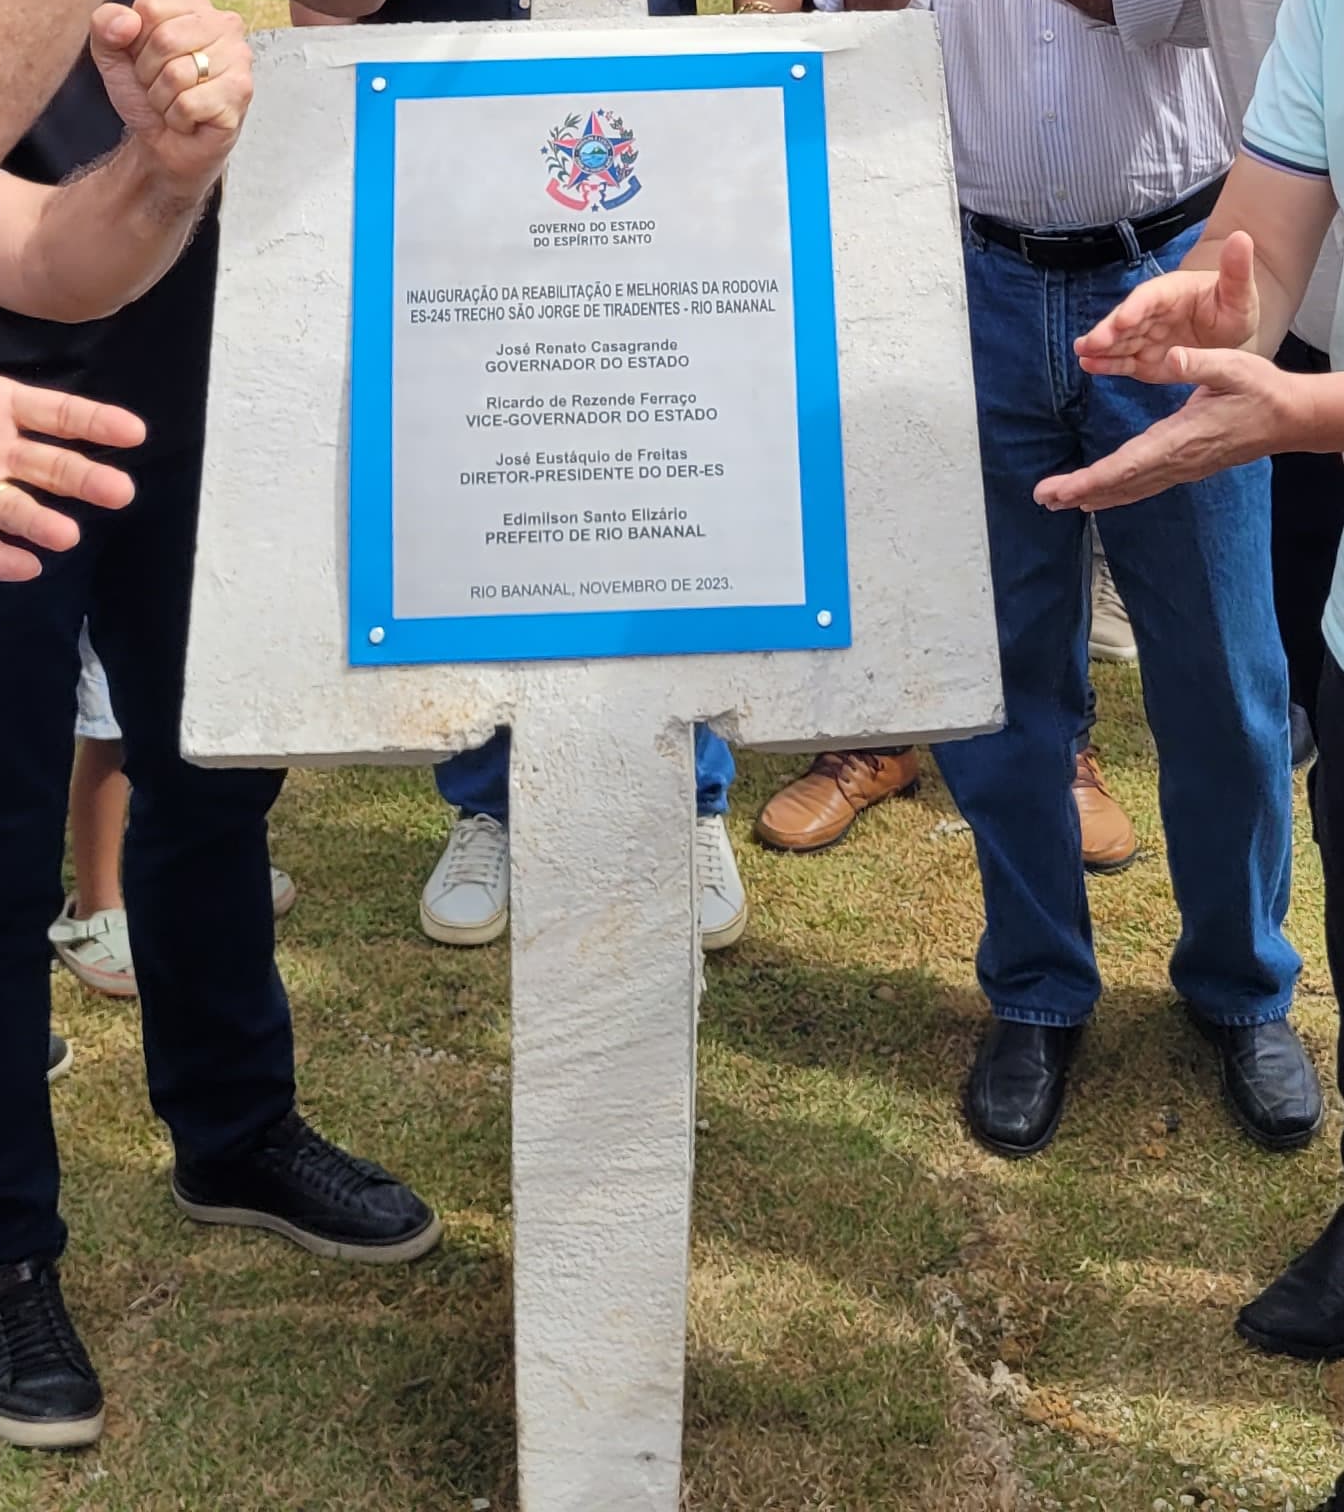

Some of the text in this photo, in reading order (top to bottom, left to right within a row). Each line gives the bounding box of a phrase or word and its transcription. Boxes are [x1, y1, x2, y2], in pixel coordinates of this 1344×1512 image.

[529, 220, 656, 234] GOVERNO DO ESTADO
[533, 233, 652, 248] DO ESPÍRITO SANTO
[406, 279, 779, 305] INAUGURAÇÃO DA REABILITAÇÃO E MELHORIAS DA RODOVIA
[410, 308, 451, 323] ES-245
[454, 306, 505, 322] TRECHO
[508, 303, 535, 321] SÃO
[538, 304, 580, 320] JORGE
[583, 303, 601, 318] DE
[603, 301, 681, 317] TIRADENTES
[691, 299, 713, 315] RIO
[716, 299, 776, 314] BANANAL
[496, 338, 678, 356] José Renato Casagrande
[485, 355, 690, 373] GOVERNADOR DO ESTADO
[486, 392, 697, 409] Ricardo de Rezende Ferraço
[466, 407, 718, 428] VICE-GOVERNADOR DO ESTADO
[495, 448, 688, 466] José Eustáquio de Freitas
[459, 463, 724, 486] DIRETOR-PRESIDENTE DO DER-ES
[503, 506, 688, 526] Edimilson Santo Elizário
[485, 524, 705, 545] PREFEITO DE RIO BANANAL
[470, 576, 733, 599] RIO BANANAL, NOVEMBRO DE 2023.
